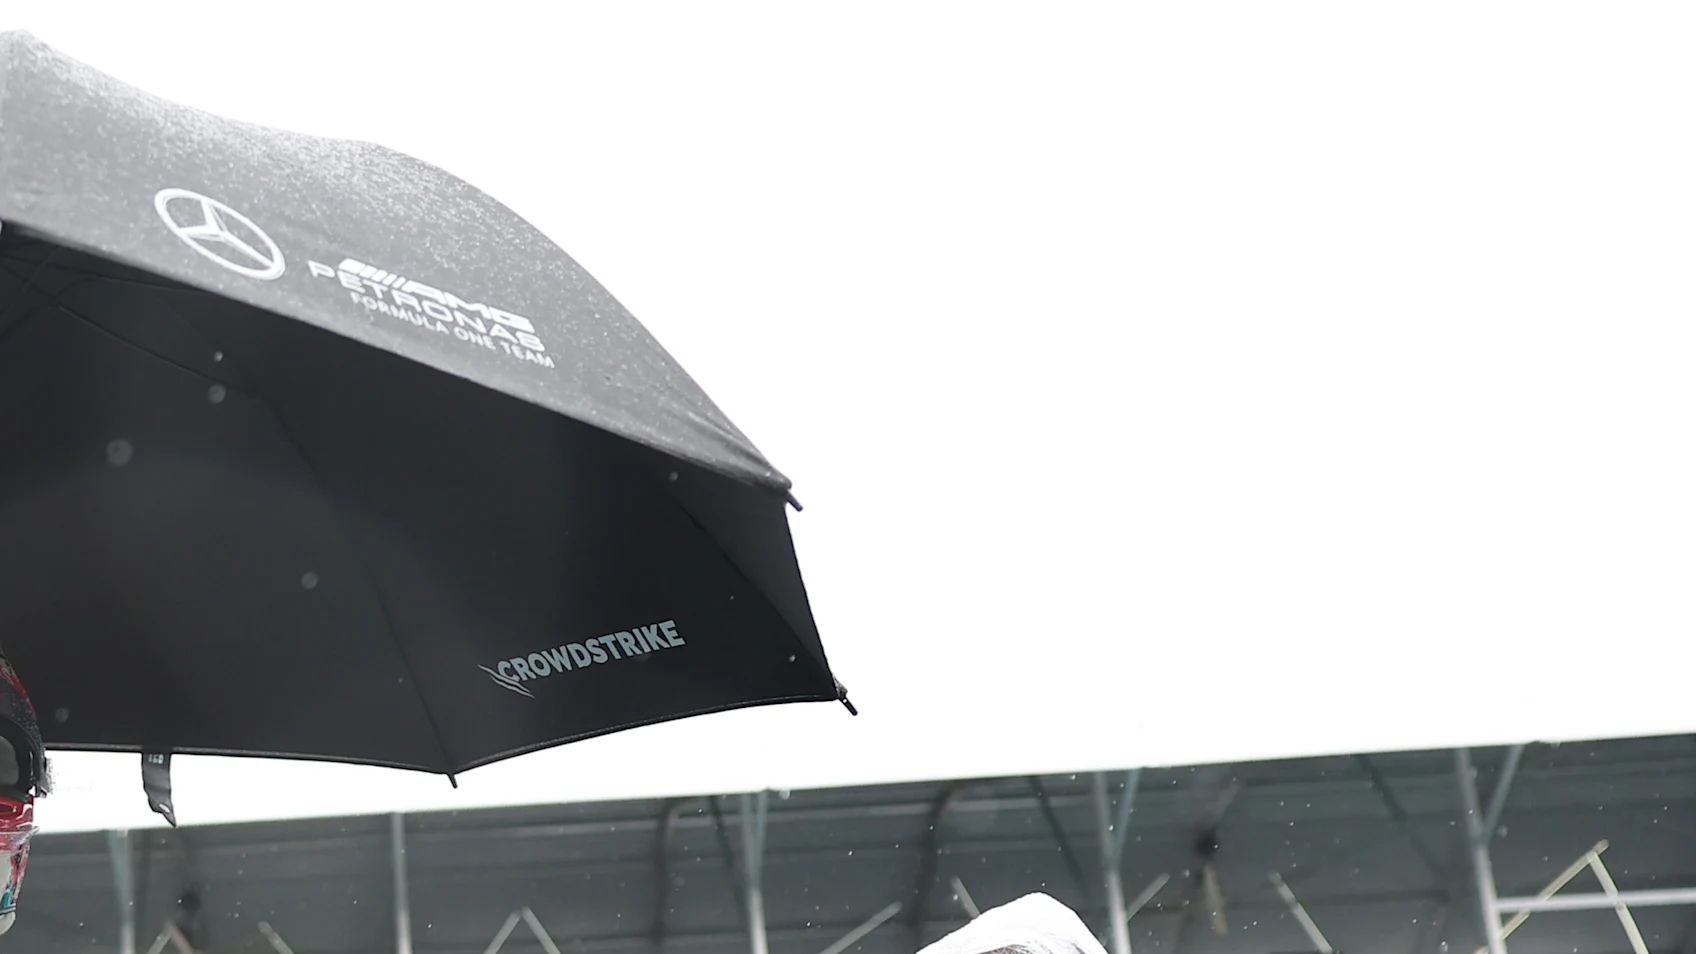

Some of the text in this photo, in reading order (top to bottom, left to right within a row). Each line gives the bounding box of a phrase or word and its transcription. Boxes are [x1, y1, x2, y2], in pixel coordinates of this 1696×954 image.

[307, 259, 546, 352] PETRONAS
[351, 291, 556, 369] FORMULA ONE TEAM
[497, 619, 687, 683] CROWDSTRIKE
